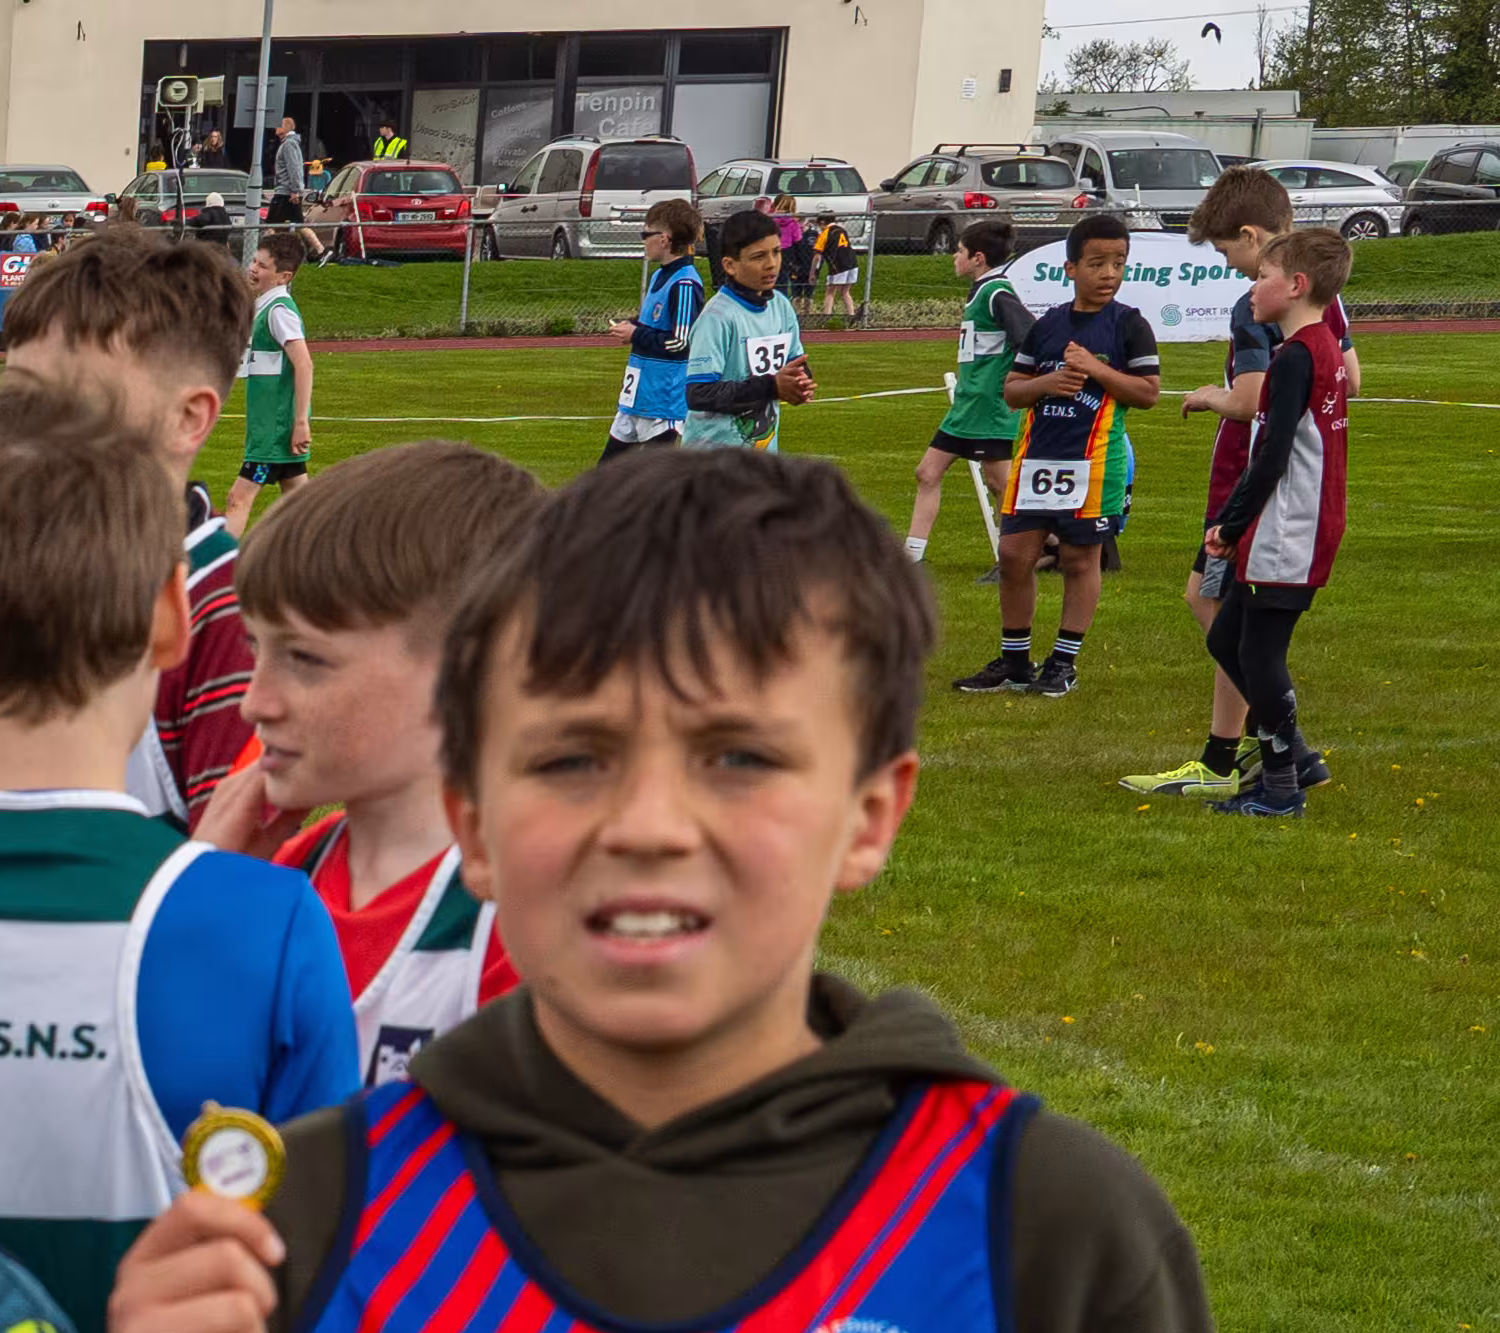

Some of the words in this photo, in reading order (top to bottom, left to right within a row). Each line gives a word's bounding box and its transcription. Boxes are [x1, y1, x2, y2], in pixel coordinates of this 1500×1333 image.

[575, 92, 656, 115] Tenpin
[1033, 263, 1171, 292] Supting
[1185, 307, 1217, 317] SPORT
[754, 343, 786, 374] 35
[623, 373, 635, 395] 2
[1043, 404, 1077, 419] E.T.N.S.
[1031, 468, 1076, 496] 65
